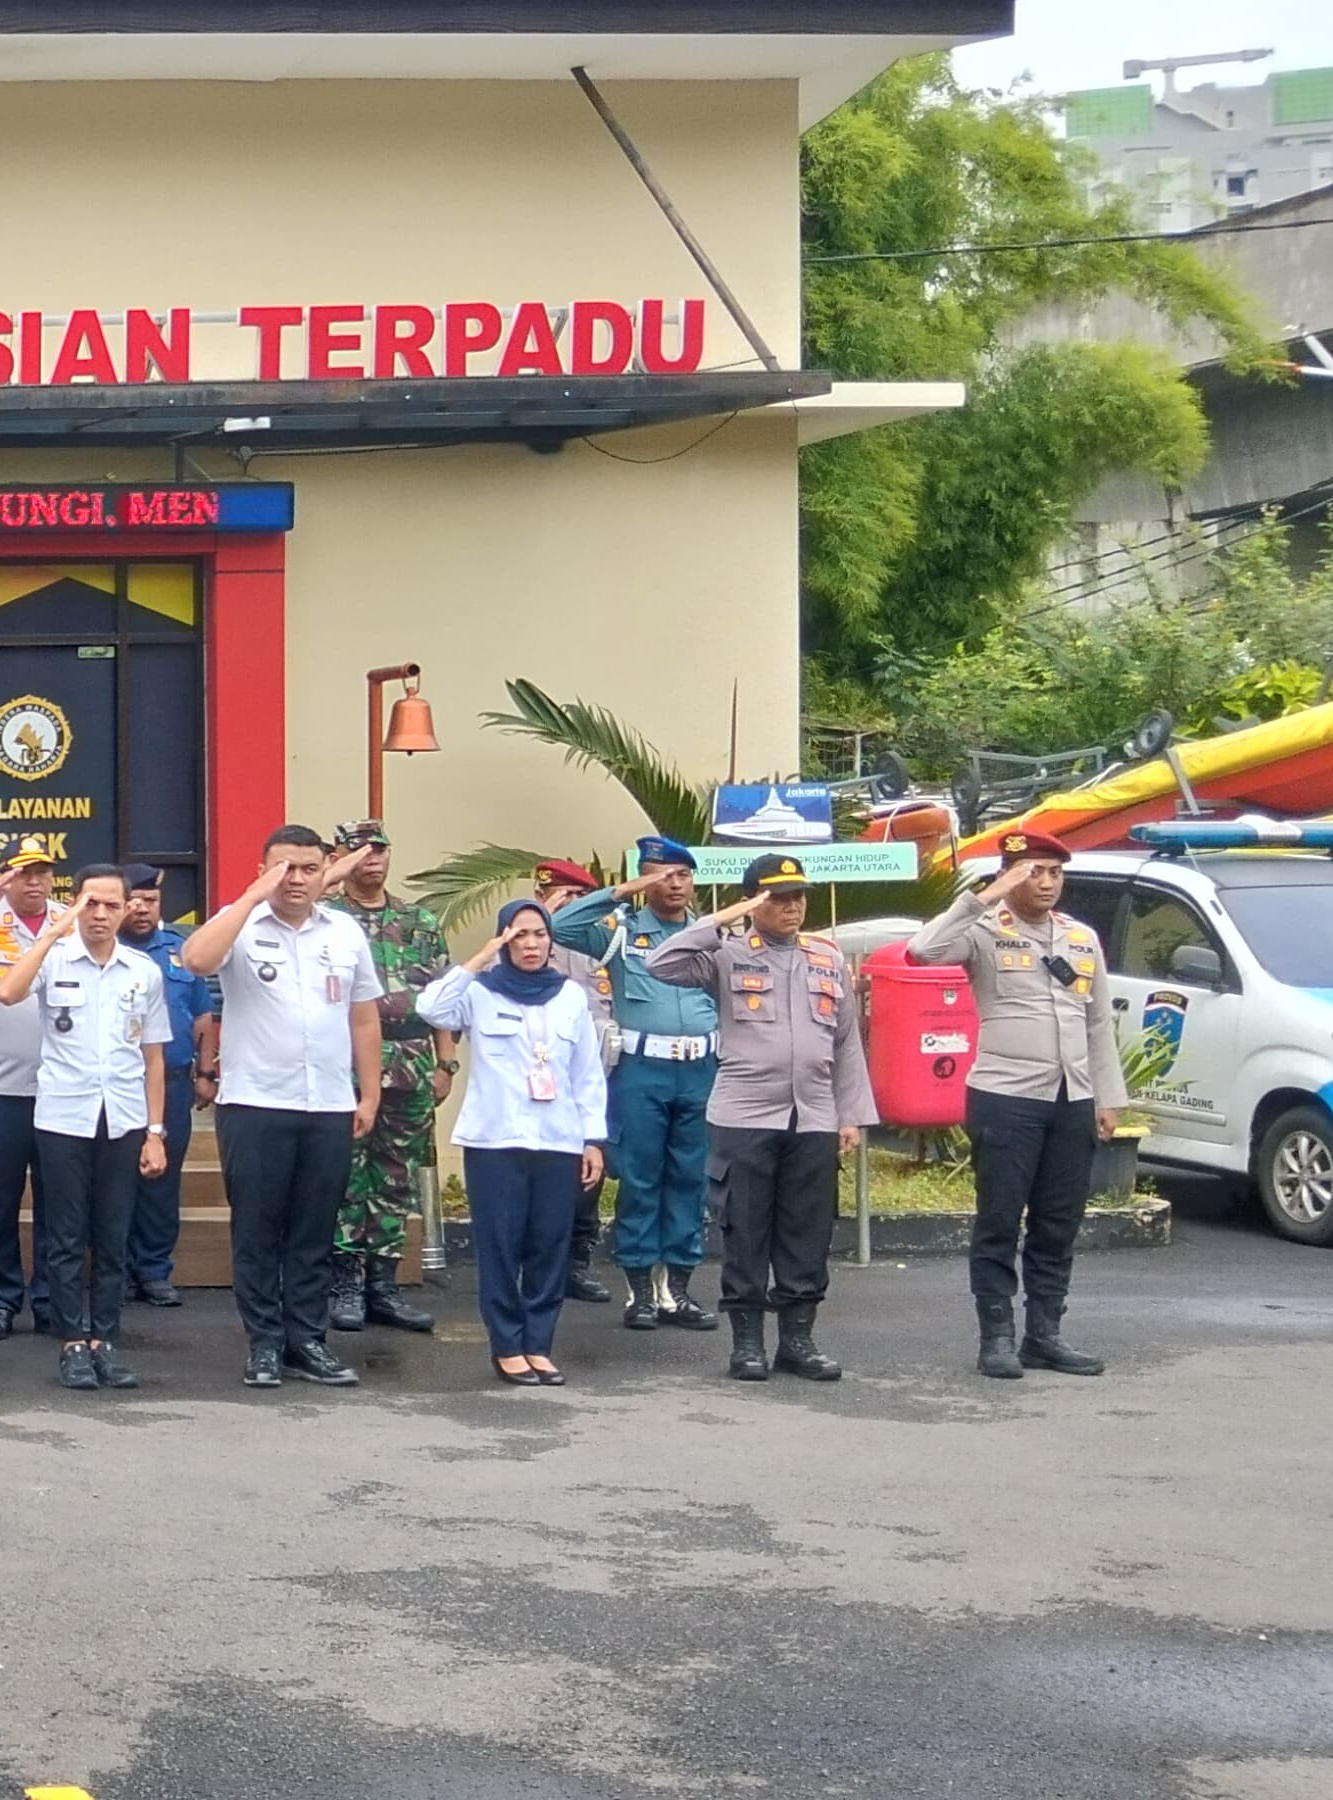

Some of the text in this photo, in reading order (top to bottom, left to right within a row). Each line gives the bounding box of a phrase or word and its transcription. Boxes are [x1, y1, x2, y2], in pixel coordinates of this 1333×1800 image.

[239, 298, 706, 380] TERPADU
[785, 786, 827, 798] Jakarta
[704, 858, 736, 867] SUKU
[856, 853, 890, 863] HIDUP
[810, 864, 862, 874] JAKARTA
[863, 862, 901, 872] UTARA
[995, 939, 1032, 950] KHALID
[807, 965, 840, 980] POLRI
[1180, 1095, 1214, 1110] GADING
